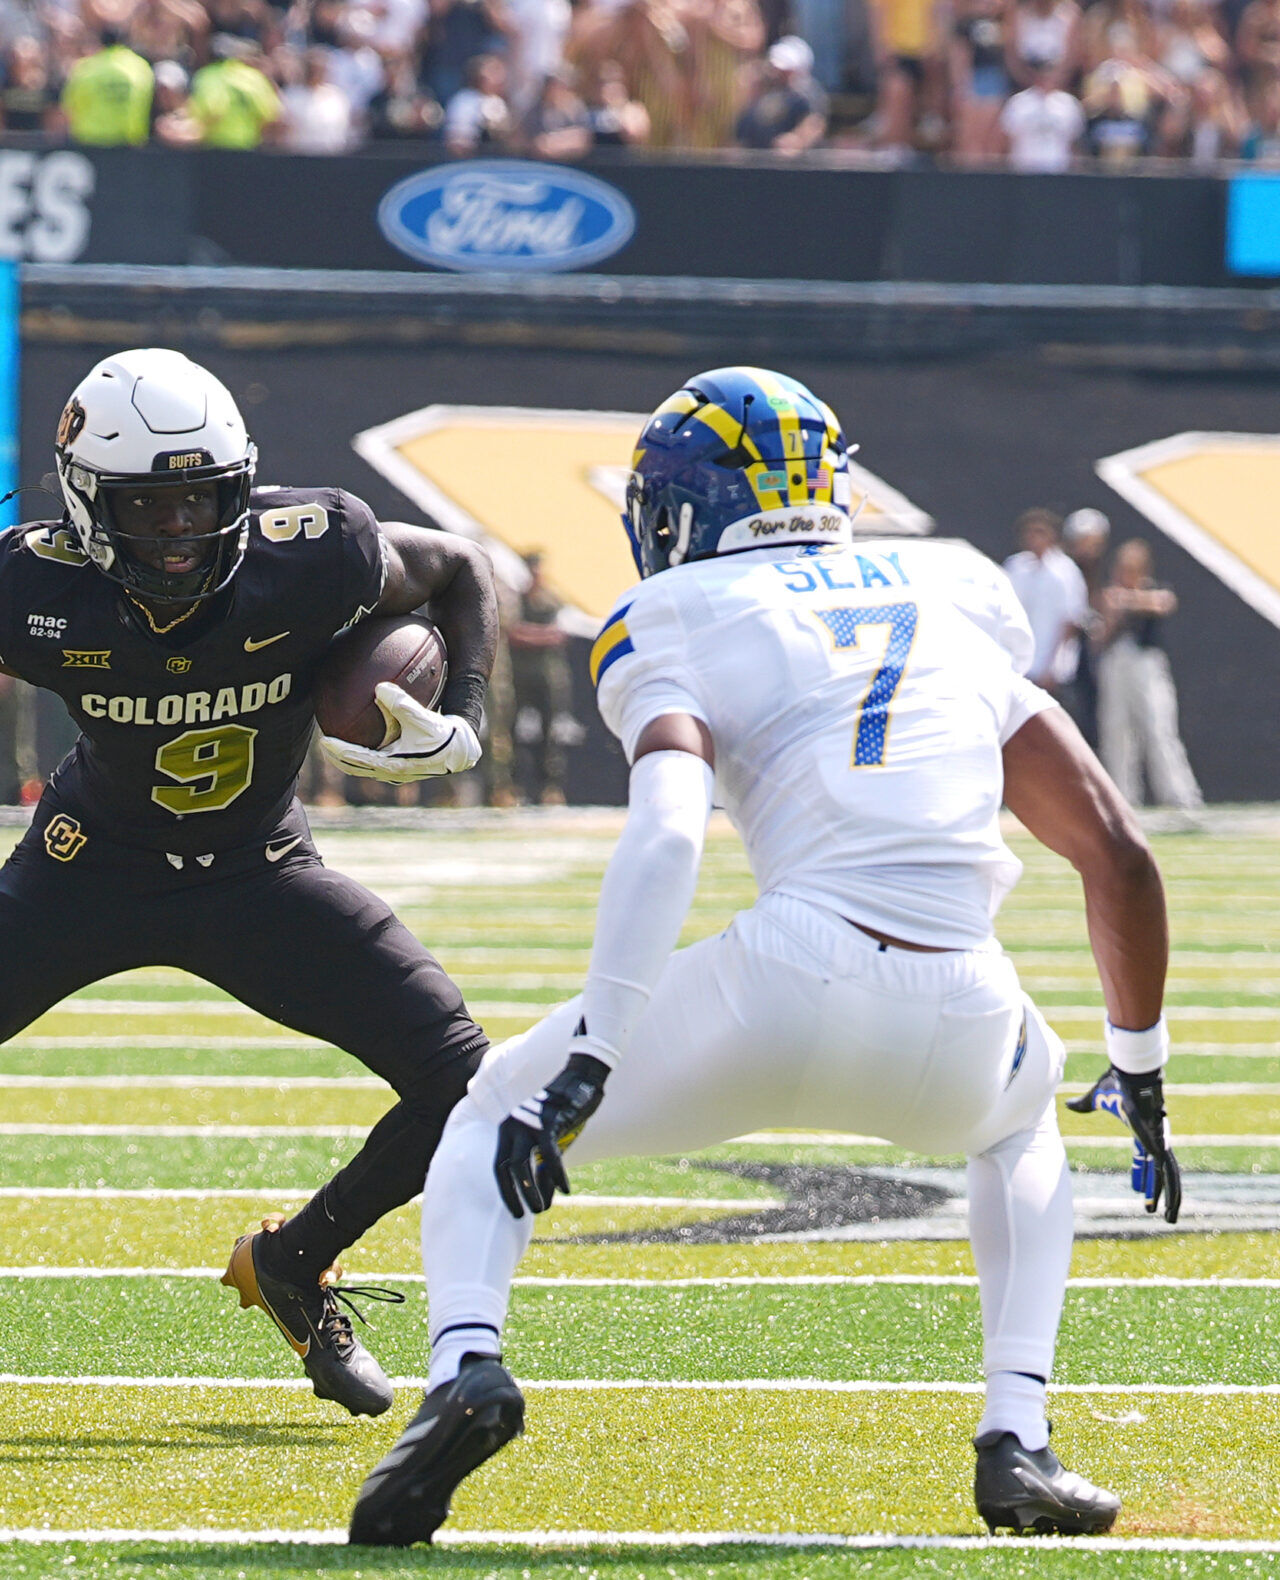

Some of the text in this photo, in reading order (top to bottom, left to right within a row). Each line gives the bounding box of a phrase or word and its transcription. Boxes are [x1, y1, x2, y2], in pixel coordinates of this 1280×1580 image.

[426, 173, 586, 253] Ford
[787, 432, 797, 453] 7
[168, 453, 202, 470] BUFFS
[749, 515, 842, 537] For the 302
[771, 552, 911, 593] SEAY
[27, 614, 68, 630] mac
[29, 627, 62, 640] 82-94
[81, 673, 292, 726] COLORADO
[813, 601, 919, 771] 7
[150, 723, 259, 816] 9
